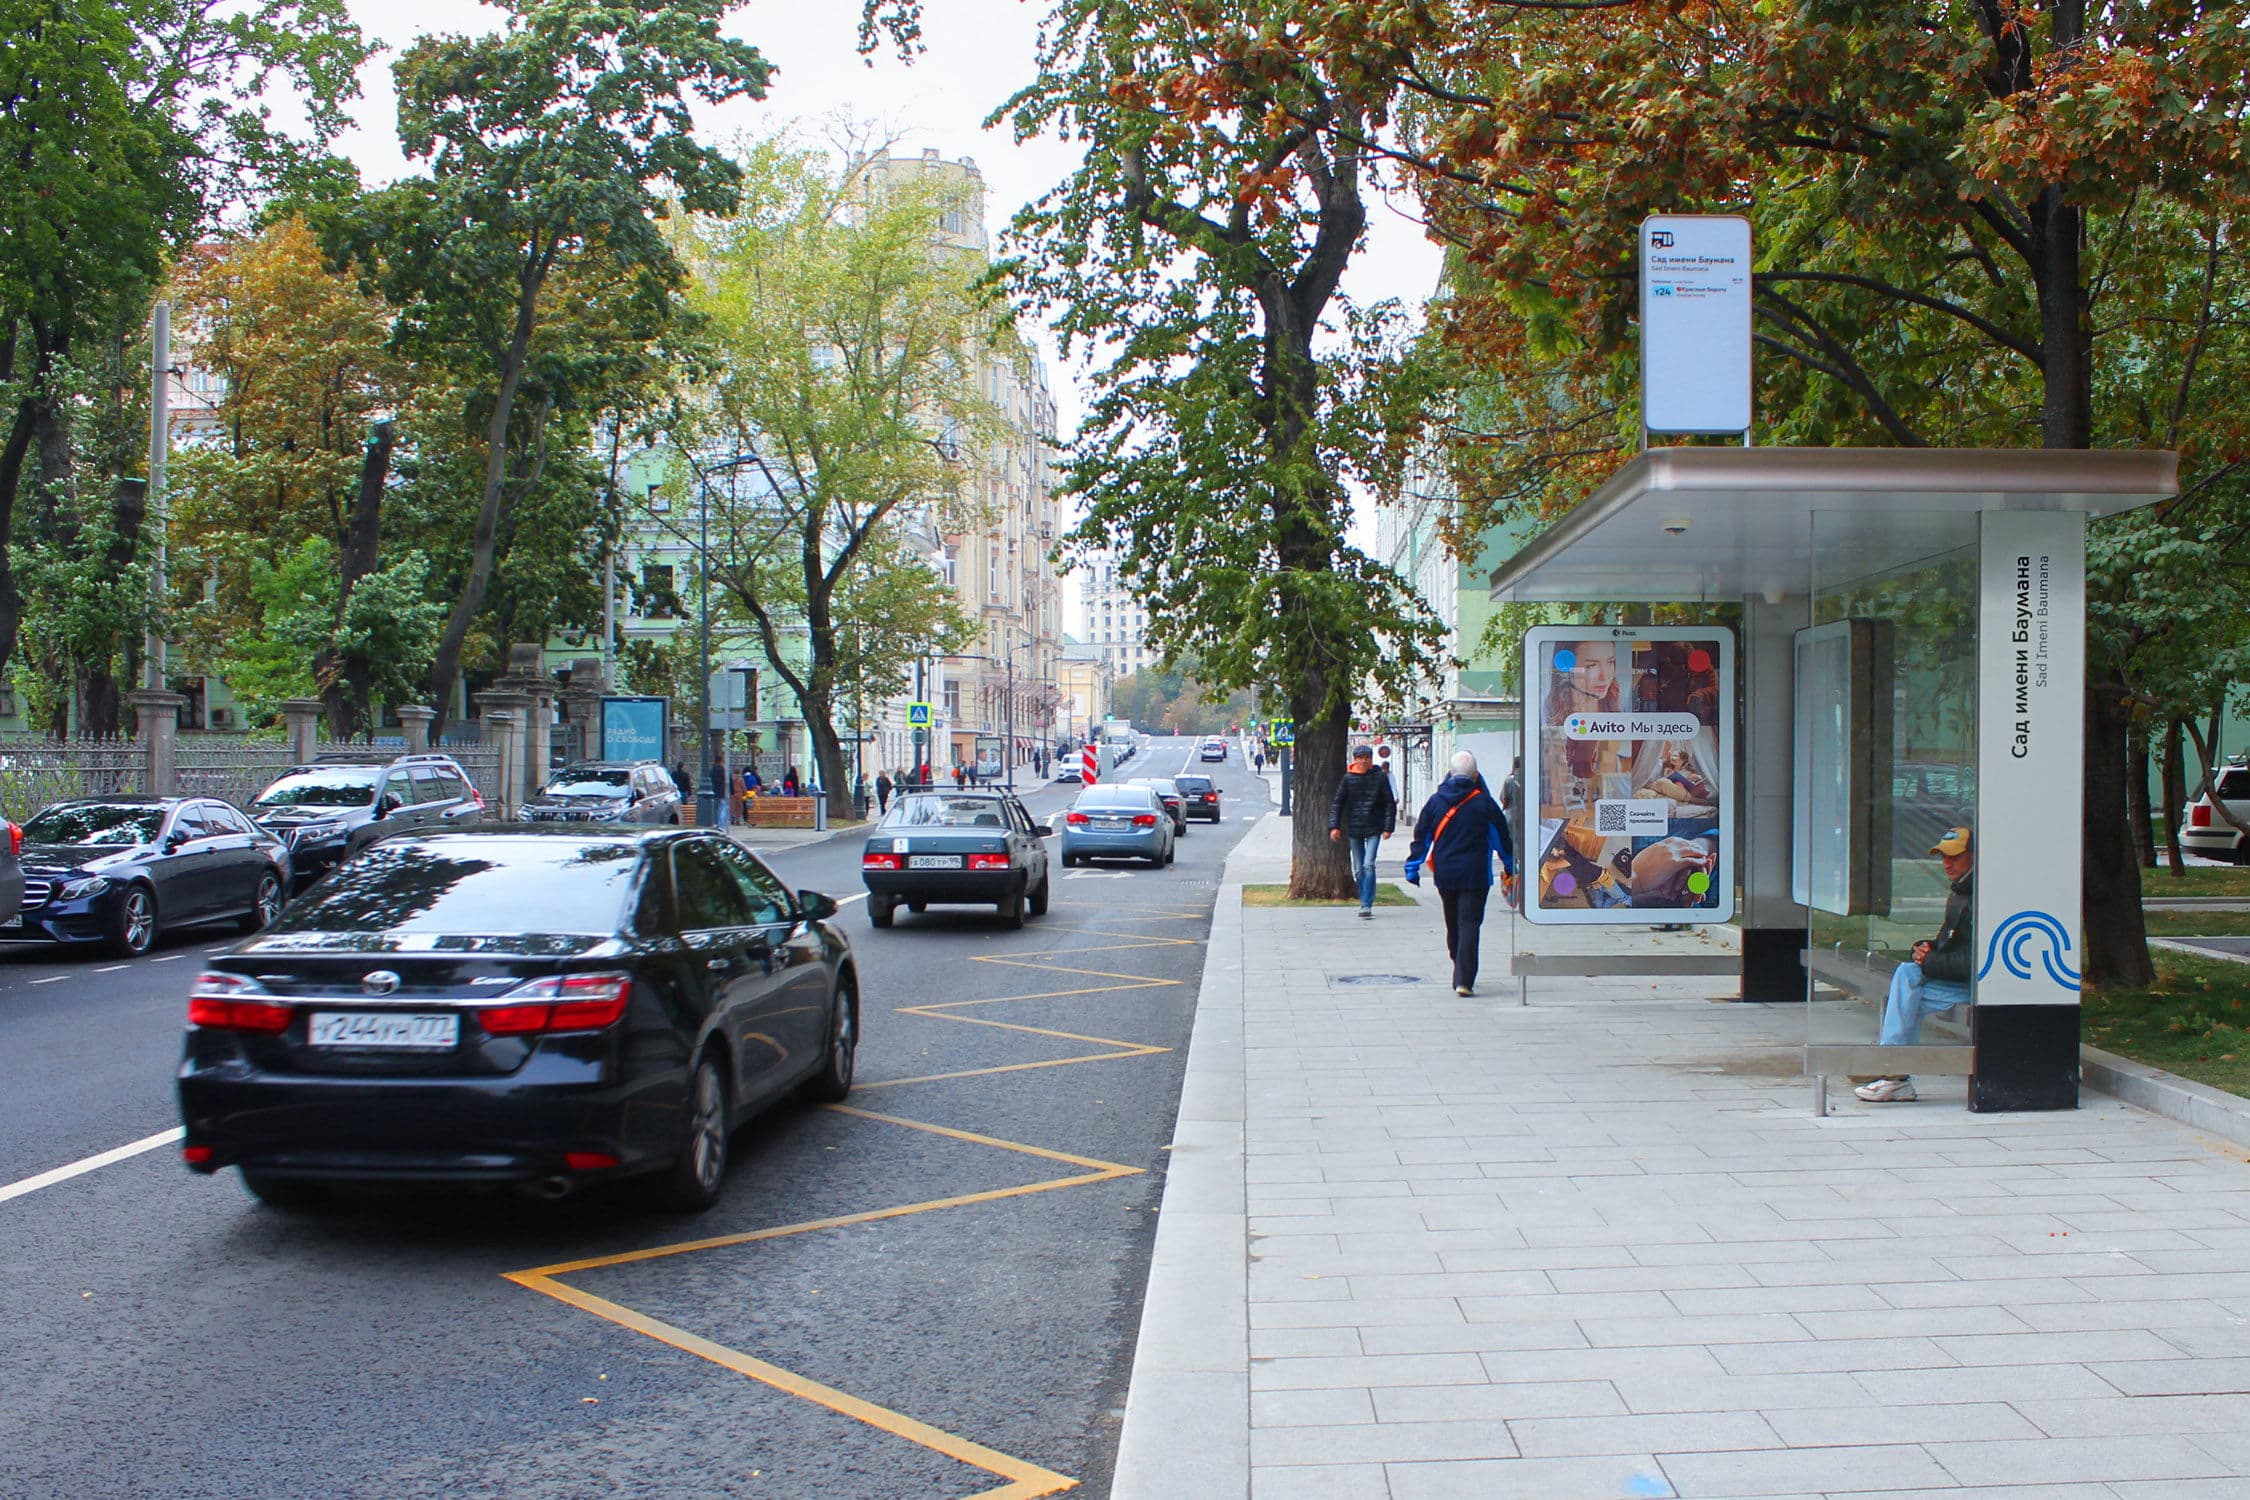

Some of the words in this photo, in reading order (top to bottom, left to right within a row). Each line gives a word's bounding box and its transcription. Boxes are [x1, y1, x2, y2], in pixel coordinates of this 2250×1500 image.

[1651, 255, 1667, 265] Сад
[1669, 256, 1696, 264] имени
[1698, 255, 1735, 266] Баумана
[2012, 555, 2033, 643] Баумана
[2037, 555, 2050, 617] Baumana
[2036, 620, 2049, 660] Imeni
[2015, 650, 2029, 714] имени
[2036, 664, 2048, 688] Sad
[1589, 720, 1626, 734] Avito
[1631, 721, 1654, 734] Мы
[1657, 723, 1693, 736] здесь
[2011, 719, 2030, 759] Сад
